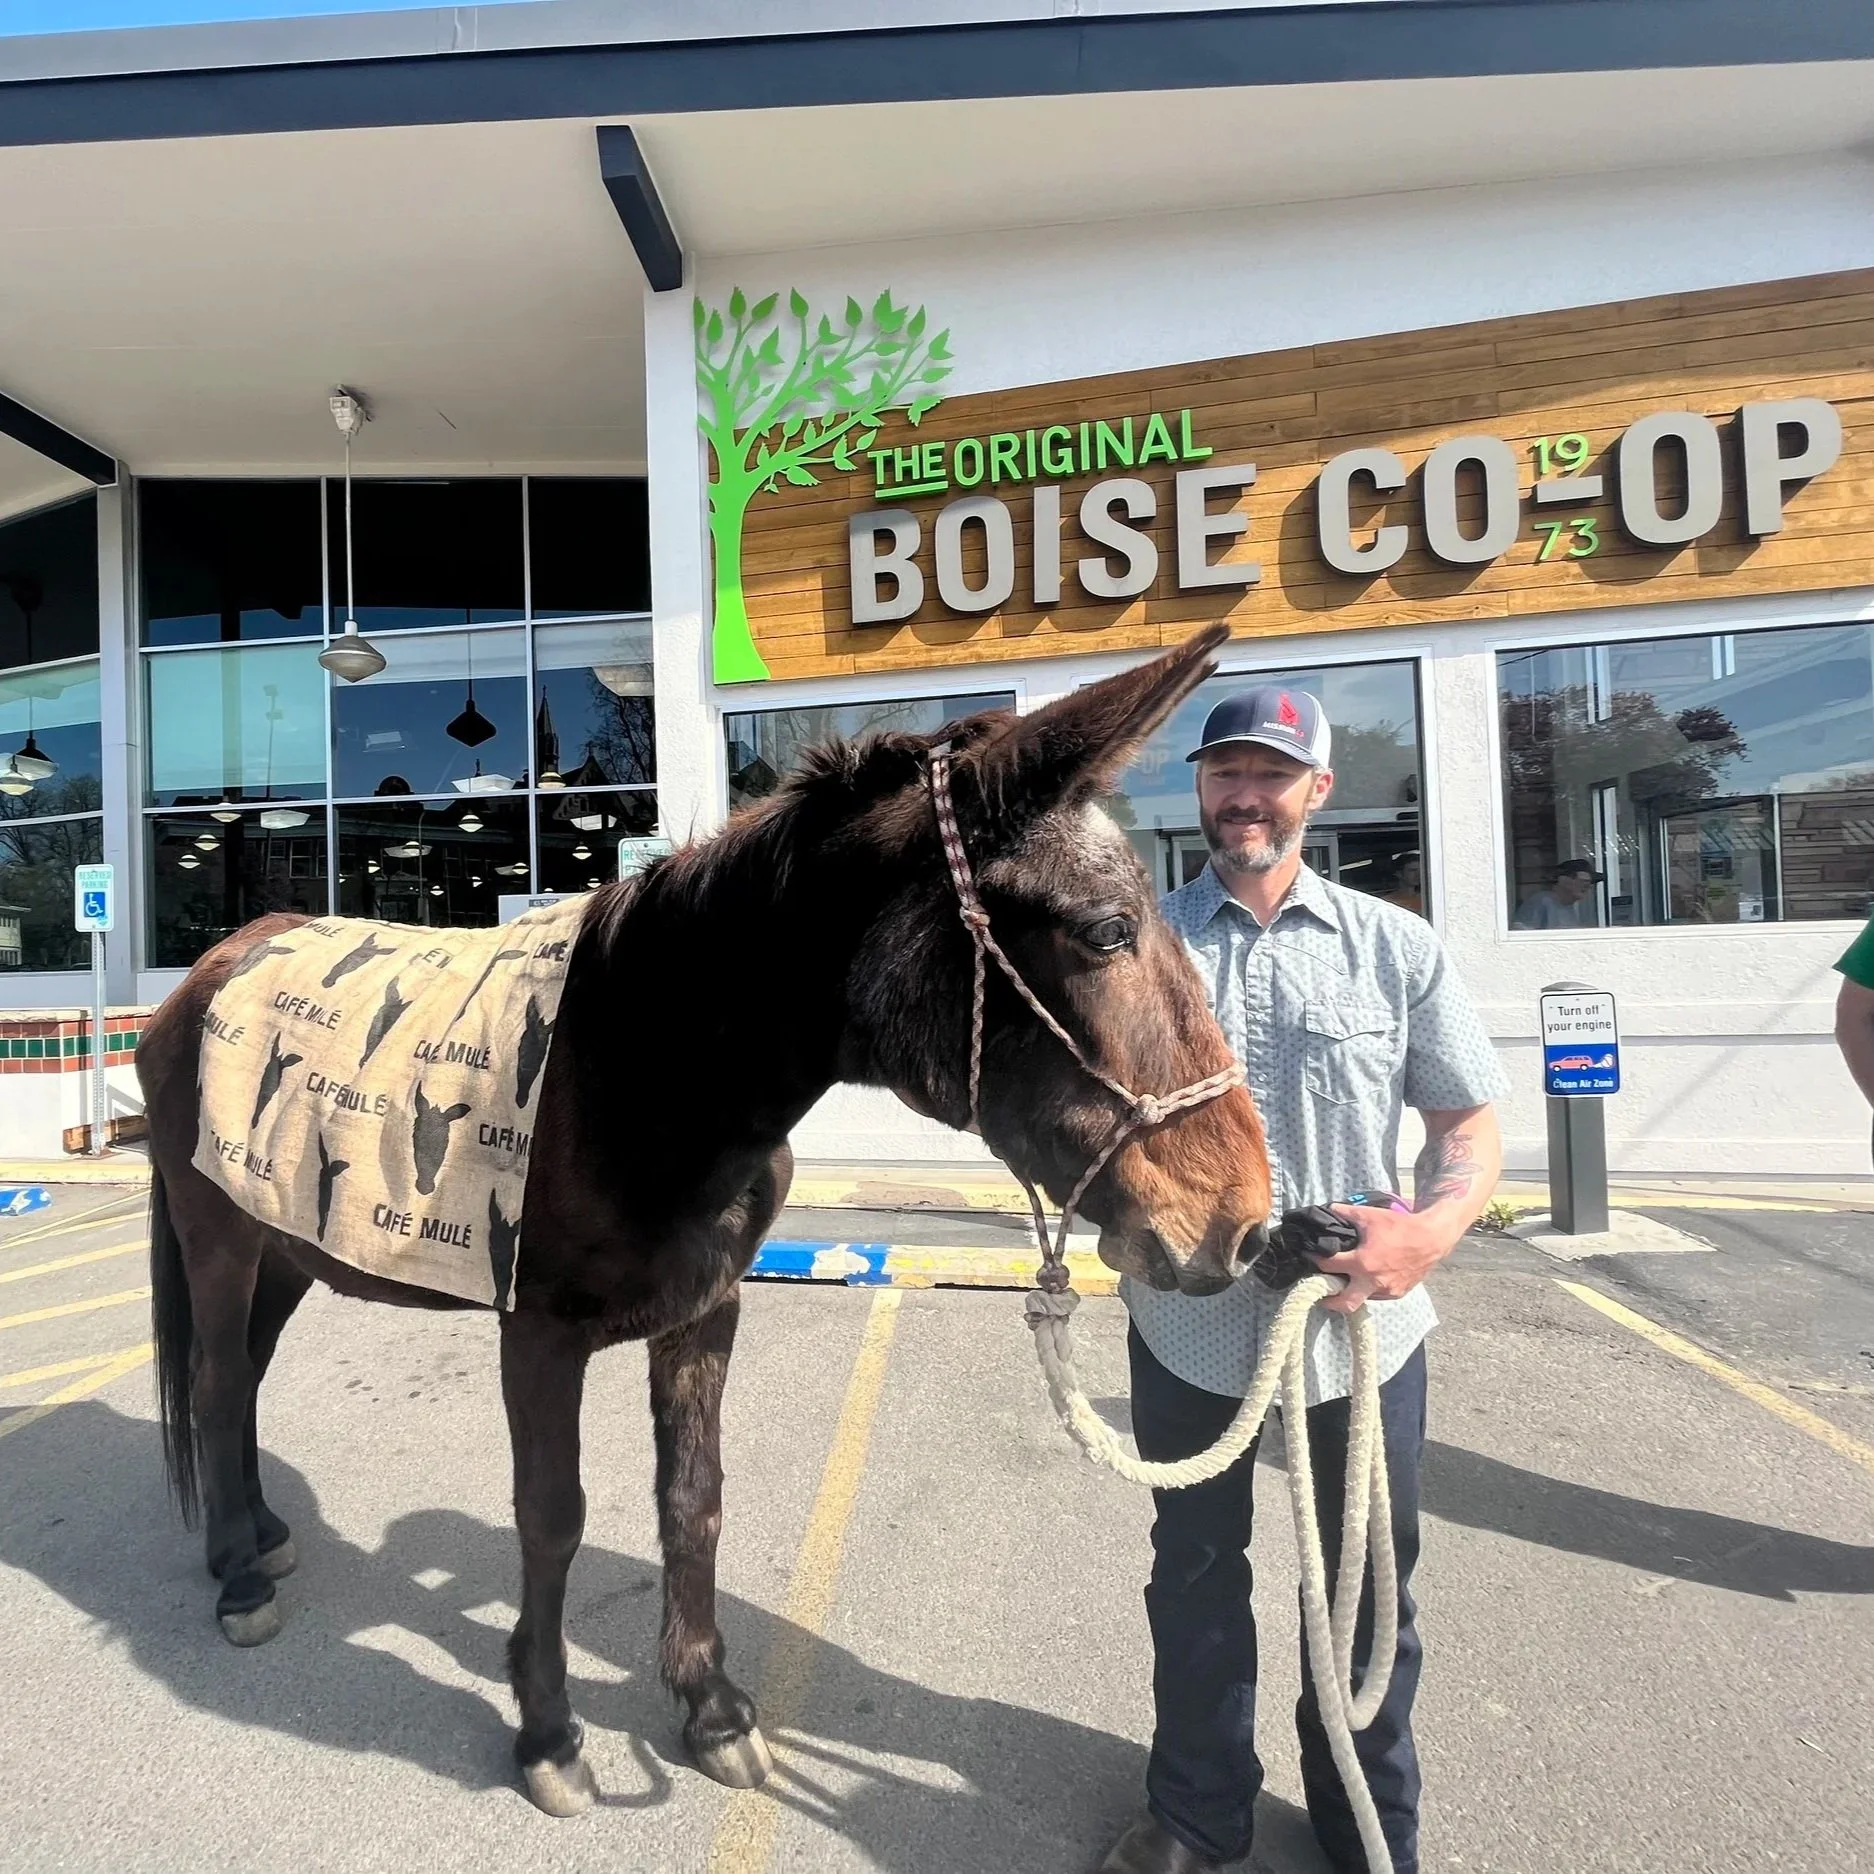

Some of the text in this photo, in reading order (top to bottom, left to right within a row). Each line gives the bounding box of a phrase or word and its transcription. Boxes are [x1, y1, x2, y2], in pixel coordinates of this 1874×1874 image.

[867, 409, 1214, 488] THE ORIGINAL
[1532, 433, 1589, 474] 19
[849, 397, 1843, 625] BOISE CO-OP
[1534, 518, 1600, 561] 73
[274, 991, 310, 1016] CAFÉ
[1557, 1005, 1599, 1016] Turn off
[1547, 1020, 1612, 1033] your engine
[445, 1041, 491, 1070] MULÉ
[1553, 1078, 1614, 1089] Clean Air Zone
[479, 1123, 514, 1152] CAFÉ
[373, 1203, 472, 1249] CAFÉ MULÉ
